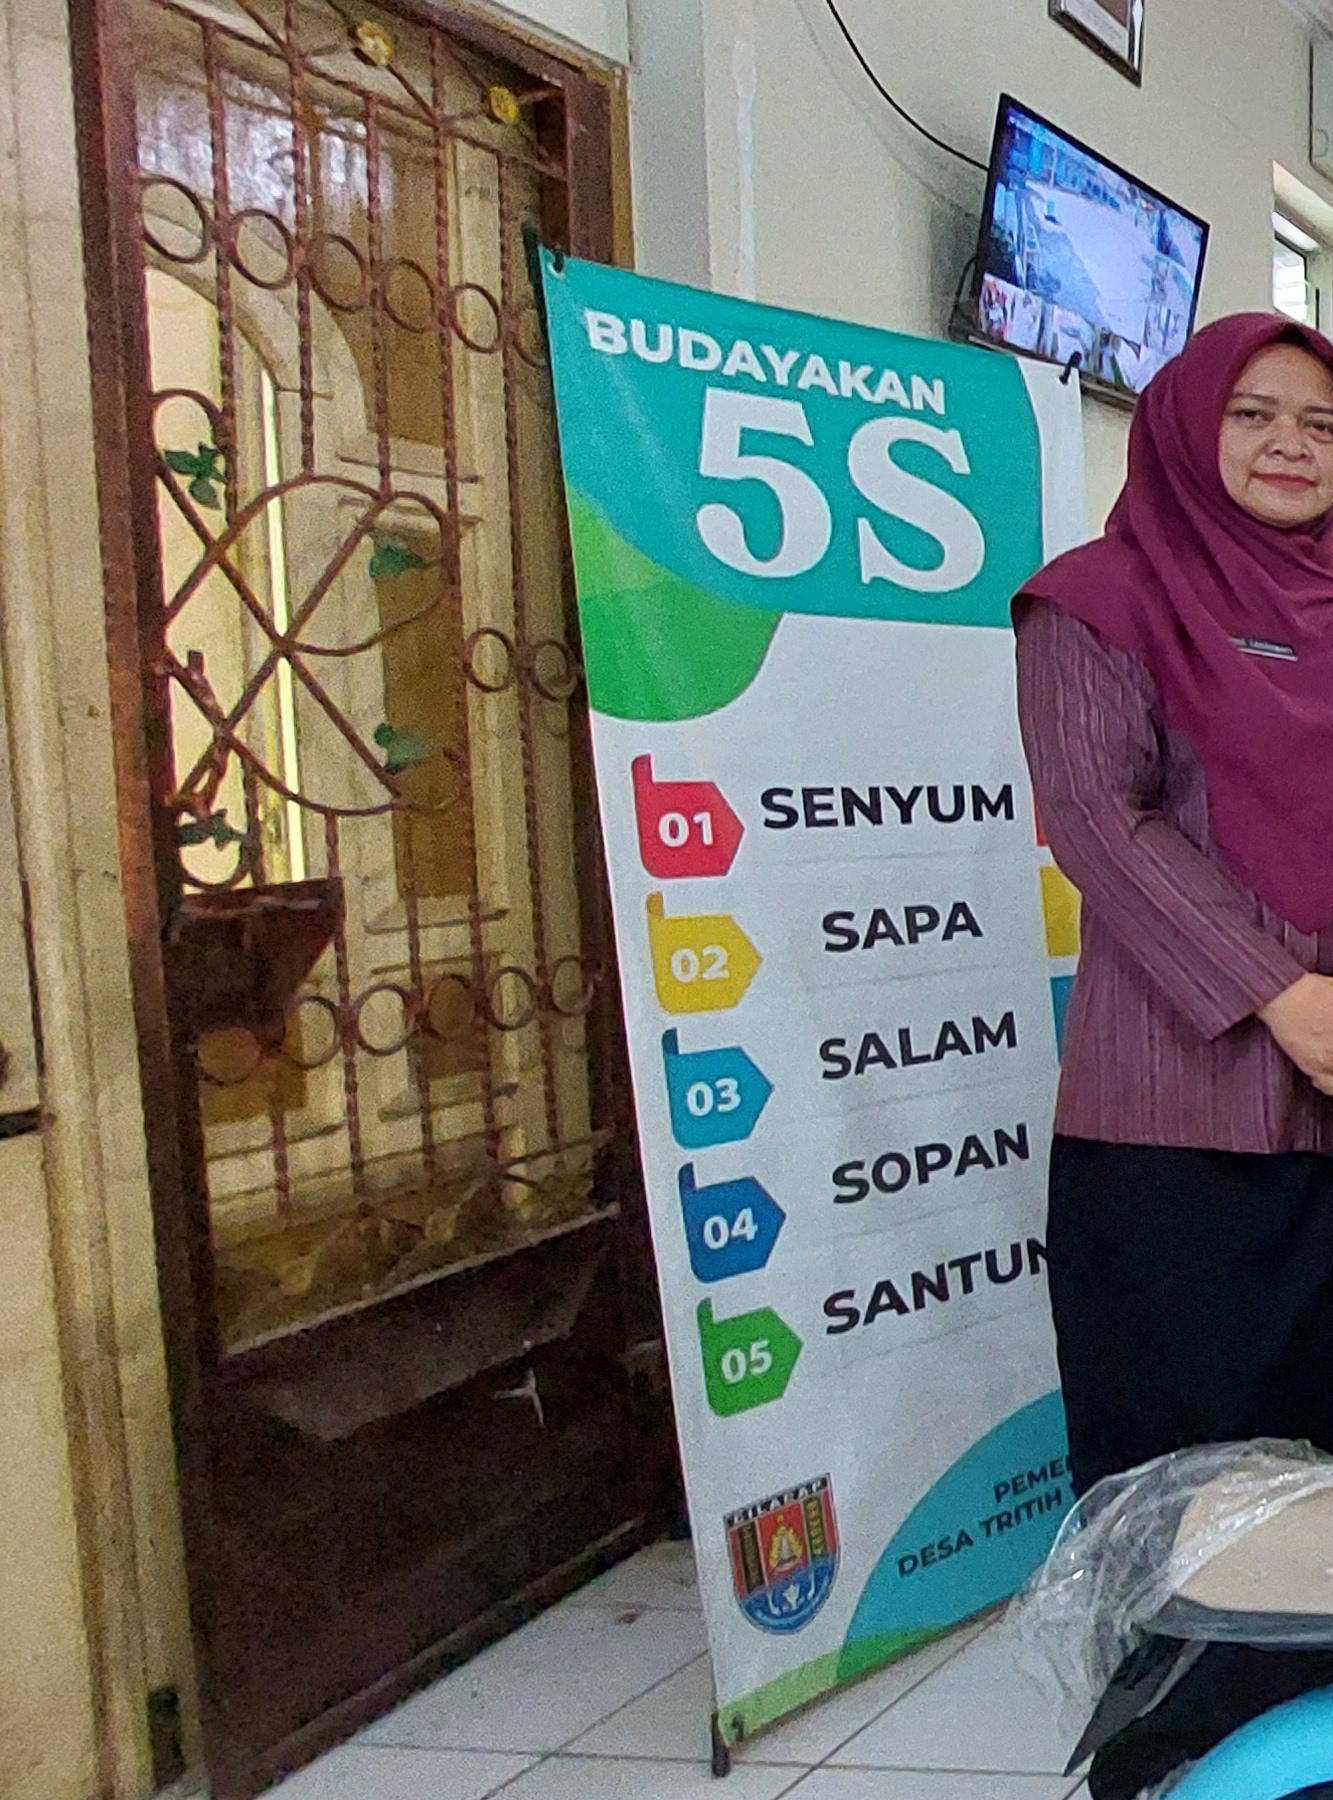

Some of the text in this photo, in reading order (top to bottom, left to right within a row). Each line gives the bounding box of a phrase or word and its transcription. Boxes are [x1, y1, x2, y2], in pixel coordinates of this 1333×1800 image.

[583, 308, 945, 416] BUDAYAKAN
[696, 387, 985, 593] 5S
[658, 783, 1015, 848] 01 SENYUM
[670, 900, 984, 983] 02 SAPA
[686, 1011, 1018, 1117] 03 SALAM
[702, 1122, 1031, 1250] 04 SOPAN
[720, 1338, 773, 1385] 05
[993, 1454, 1071, 1504] PEME
[897, 1488, 1063, 1578] DESA TRITIH
